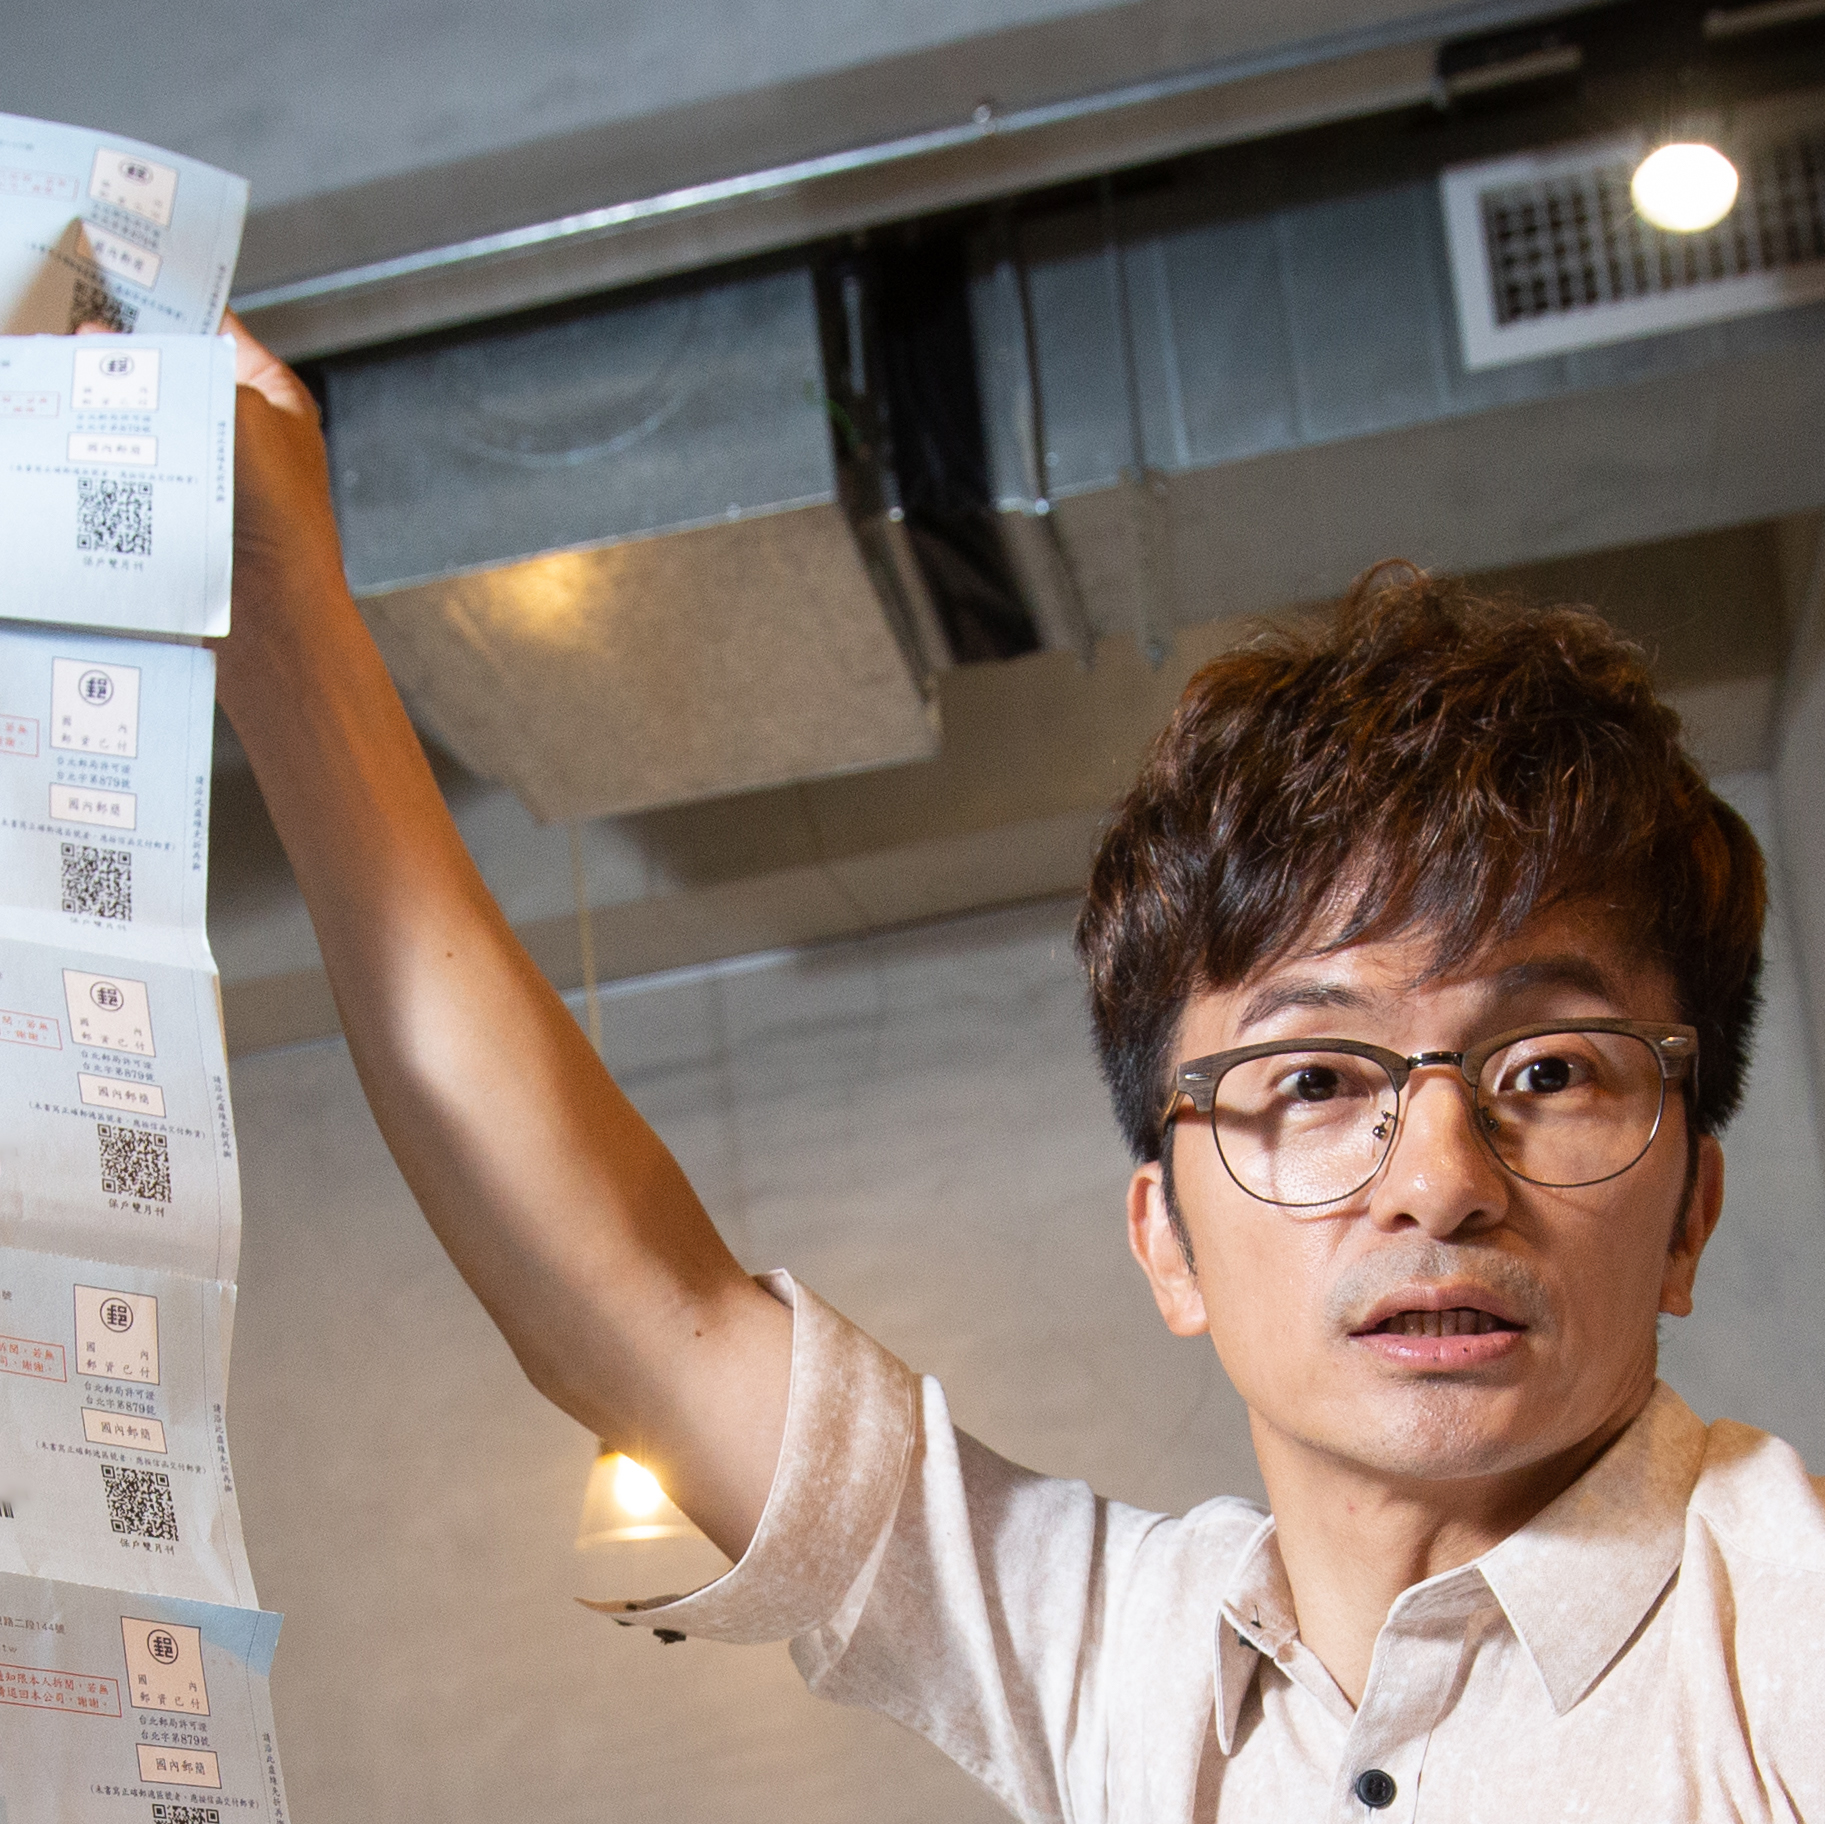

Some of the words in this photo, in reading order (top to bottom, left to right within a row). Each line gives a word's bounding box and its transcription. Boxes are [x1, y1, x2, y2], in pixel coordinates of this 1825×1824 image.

[98, 1086, 149, 1105] 國內郵簡
[108, 1198, 165, 1217] 保戶雙月刊
[101, 1421, 151, 1441] 國內郵簡
[120, 1537, 175, 1555] 保戶雙月刊
[141, 1730, 210, 1747] 台北字第879號
[155, 1757, 206, 1776] 國內郵簡
